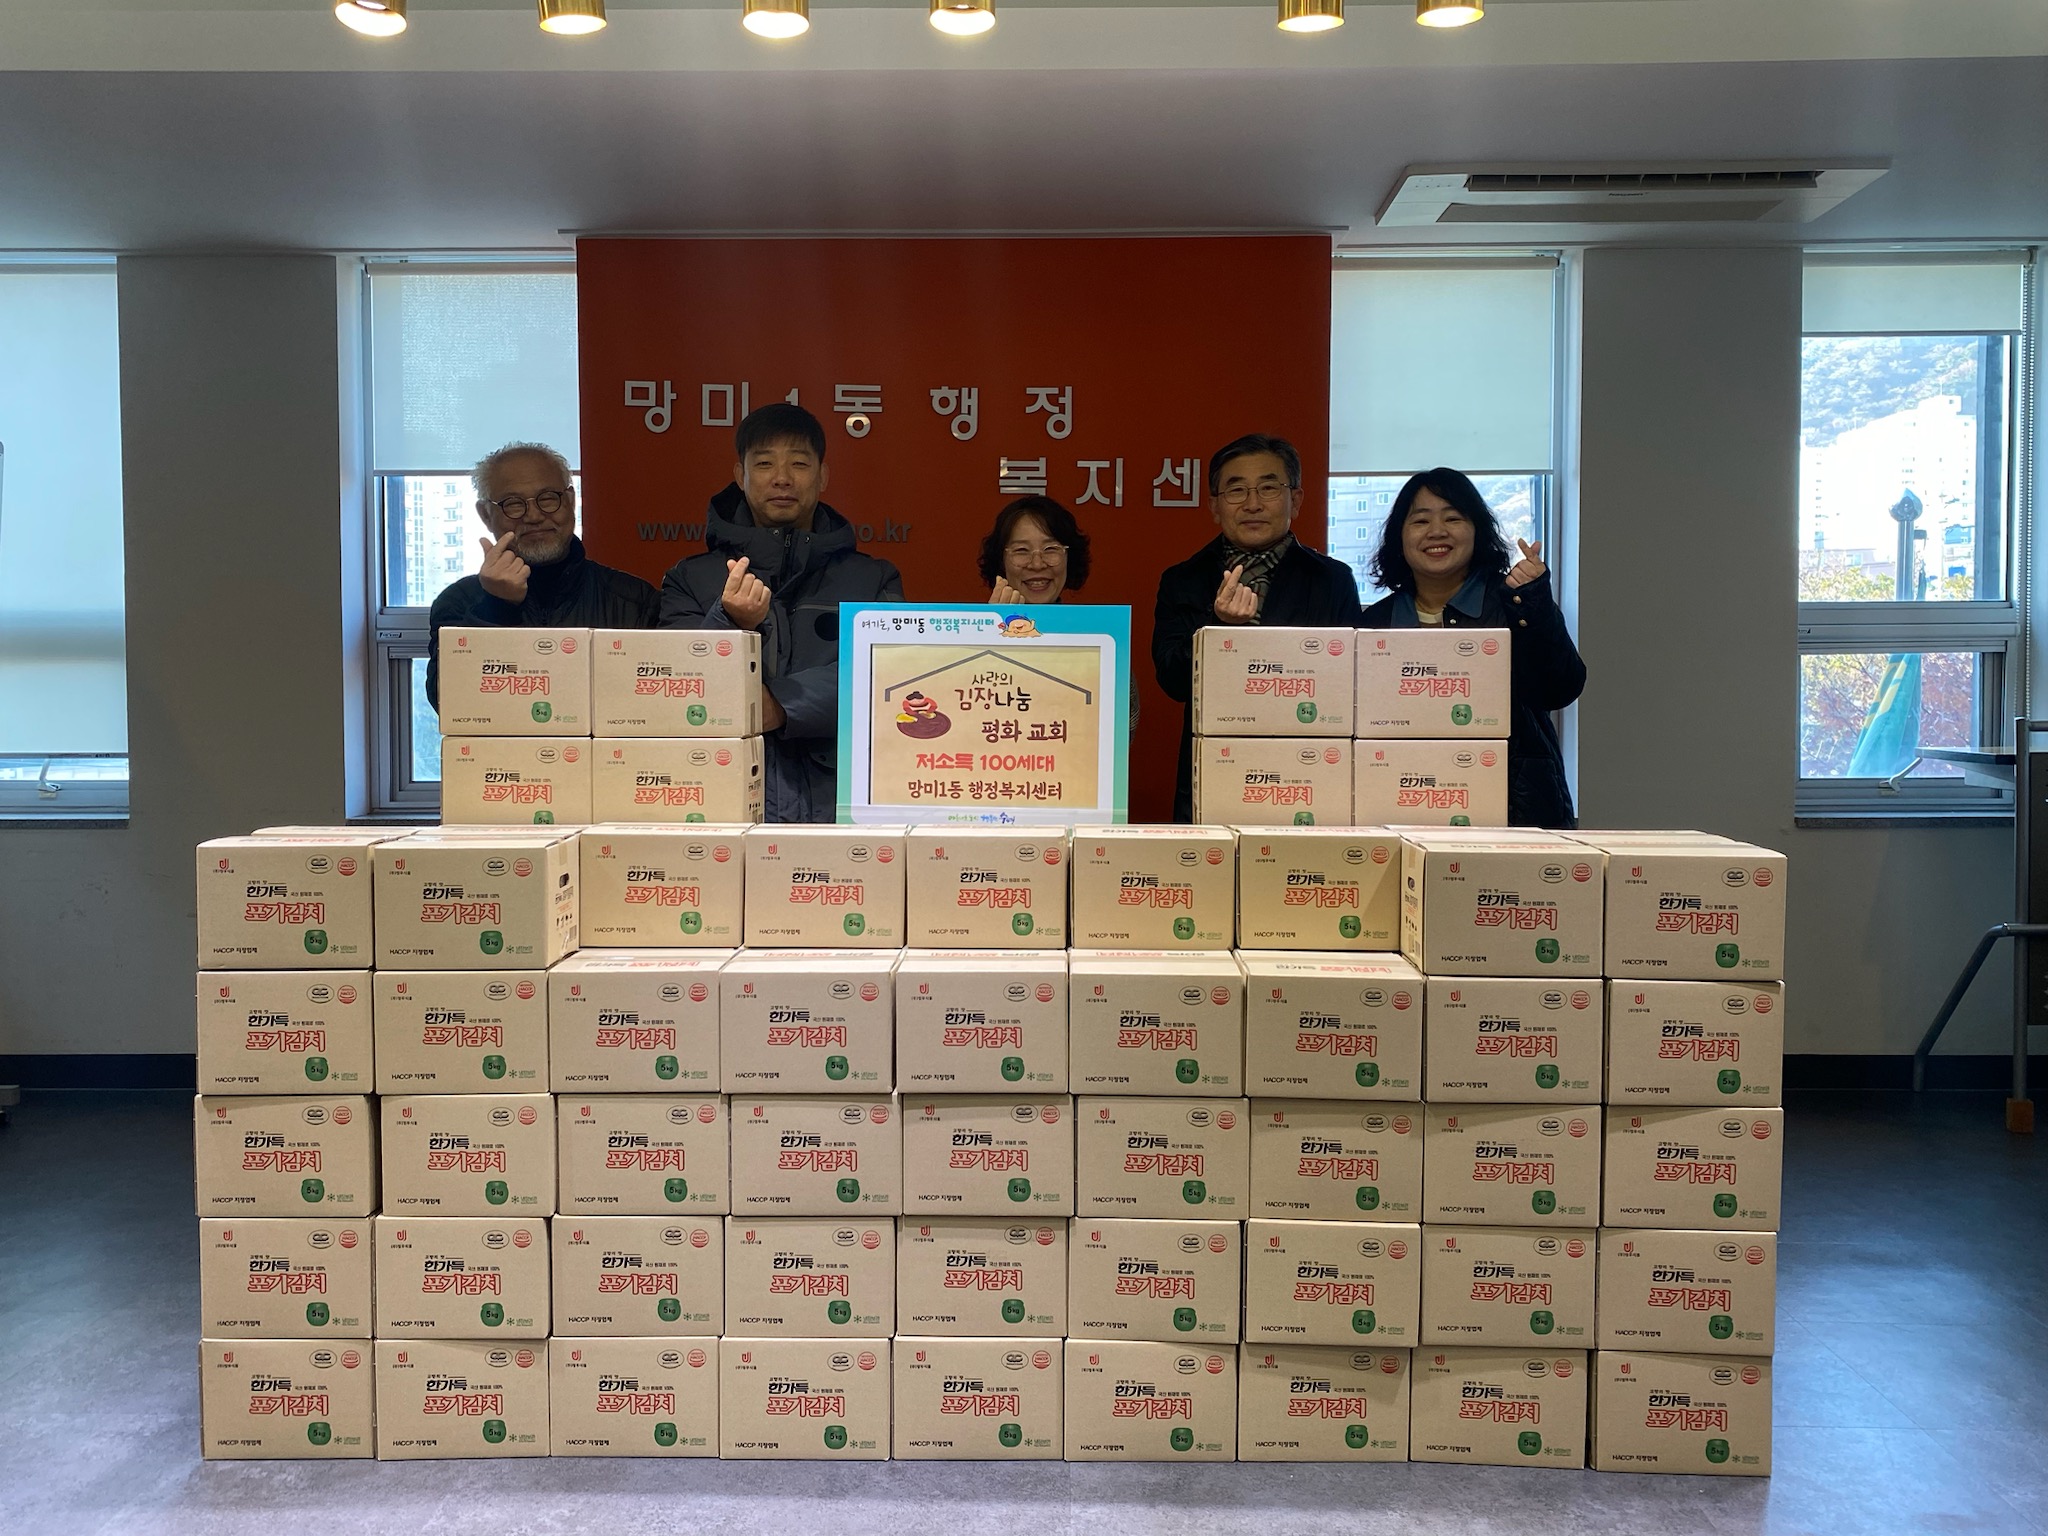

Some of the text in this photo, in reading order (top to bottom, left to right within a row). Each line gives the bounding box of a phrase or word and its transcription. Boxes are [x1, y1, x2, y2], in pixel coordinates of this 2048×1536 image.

[892, 618, 925, 634] 망미1동
[929, 618, 994, 634] 행정복지센터
[482, 664, 518, 675] 한가득
[637, 666, 672, 677] 한가득
[971, 671, 1013, 686] 사랑의
[1248, 664, 1284, 674] 한가득
[1401, 666, 1438, 677] 한가득
[479, 675, 550, 696] 포기김치
[635, 678, 705, 698] 포기김치
[1244, 677, 1315, 698] 포기김치
[1399, 678, 1470, 698] 포기김치
[954, 686, 1032, 712] 김장나눔
[981, 720, 1068, 744] 평화 교회
[915, 753, 1055, 772] 저소득 100세대
[485, 772, 521, 783] 한가득
[636, 775, 672, 786] 한가득
[1245, 773, 1281, 784] 한가득
[1400, 777, 1436, 788] 한가득
[483, 784, 552, 804] 포기김치
[634, 787, 704, 806] 포기김치
[907, 781, 1062, 800] 망미1동 행정복지센터
[1242, 785, 1313, 806] 포기김치
[1397, 789, 1468, 809] 포기김치
[627, 870, 666, 882] 한가득
[792, 872, 830, 884] 한가득
[960, 872, 998, 883] 한가득
[1121, 876, 1159, 887] 한가득
[1287, 874, 1326, 885] 한가득
[247, 886, 288, 898] 한가득
[423, 888, 464, 900] 한가득
[625, 885, 700, 907] 포기김치
[790, 884, 864, 906] 포기김치
[957, 888, 1031, 909] 포기김치
[1119, 887, 1193, 909] 포기김치
[1284, 887, 1360, 908] 포기김치
[1478, 894, 1520, 906] 한가득
[244, 902, 325, 925] 포기김치
[420, 902, 501, 925] 포기김치
[1659, 898, 1702, 910] 한가득
[1475, 907, 1557, 930] 포기김치
[1656, 911, 1738, 935] 포기김치
[248, 1015, 289, 1027] 한가득
[425, 1012, 466, 1024] 한가득
[598, 1014, 640, 1026] 한가득
[769, 1011, 810, 1023] 한가득
[945, 1013, 986, 1025] 한가득
[1120, 1016, 1161, 1028] 한가득
[1299, 1016, 1341, 1029] 한가득
[1479, 1020, 1521, 1033] 한가득
[422, 1025, 503, 1048] 포기김치
[596, 1027, 676, 1050] 포기김치
[768, 1026, 847, 1048] 포기김치
[942, 1026, 1023, 1049] 포기김치
[1117, 1028, 1198, 1051] 포기김치
[1662, 1025, 1704, 1038] 한가득
[245, 1030, 326, 1053] 포기김치
[1295, 1034, 1377, 1057] 포기김치
[1475, 1035, 1558, 1058] 포기김치
[1659, 1039, 1740, 1062] 포기김치
[244, 1136, 285, 1148] 한가득
[429, 1138, 470, 1150] 한가득
[608, 1136, 649, 1148] 한가득
[781, 1136, 822, 1148] 한가득
[952, 1134, 993, 1146] 한가득
[1128, 1137, 1169, 1149] 한가득
[1301, 1142, 1342, 1154] 한가득
[242, 1150, 321, 1173] 포기김치
[427, 1151, 506, 1173] 포기김치
[606, 1149, 685, 1171] 포기김치
[777, 1149, 858, 1172] 포기김치
[949, 1149, 1028, 1171] 포기김치
[1476, 1146, 1518, 1159] 한가득
[1657, 1147, 1699, 1160] 한가득
[1123, 1153, 1204, 1176] 포기김치
[1298, 1157, 1378, 1180] 포기김치
[1472, 1161, 1555, 1185] 포기김치
[1654, 1161, 1736, 1185] 포기김치
[249, 1260, 290, 1272] 한가득
[424, 1260, 465, 1272] 한가득
[602, 1256, 642, 1268] 한가득
[773, 1257, 814, 1269] 한가득
[946, 1255, 987, 1267] 한가득
[1118, 1263, 1159, 1275] 한가득
[944, 1269, 1023, 1291] 포기김치
[1298, 1266, 1339, 1278] 한가득
[1473, 1266, 1515, 1278] 한가득
[1653, 1270, 1695, 1283] 한가득
[248, 1272, 327, 1295] 포기김치
[422, 1273, 501, 1296] 포기김치
[599, 1273, 678, 1296] 포기김치
[770, 1274, 849, 1297] 포기김치
[1115, 1276, 1195, 1299] 포기김치
[1470, 1281, 1552, 1305] 포기김치
[1292, 1282, 1375, 1306] 포기김치
[1648, 1288, 1731, 1312] 포기김치
[251, 1380, 292, 1392] 한가득
[426, 1379, 468, 1391] 한가득
[598, 1380, 639, 1392] 한가득
[768, 1382, 809, 1394] 한가득
[943, 1381, 984, 1393] 한가득
[1115, 1385, 1156, 1397] 한가득
[1290, 1381, 1331, 1393] 한가득
[1462, 1386, 1504, 1399] 한가득
[248, 1394, 329, 1417] 포기김치
[423, 1394, 503, 1417] 포기김치
[596, 1393, 675, 1415] 포기김치
[766, 1395, 845, 1418] 포기김치
[941, 1394, 1020, 1417] 포기김치
[1113, 1398, 1192, 1420] 포기김치
[1288, 1397, 1367, 1420] 포기김치
[1649, 1395, 1691, 1407] 한가득
[1458, 1401, 1540, 1424] 포기김치
[1646, 1408, 1728, 1432] 포기김치
